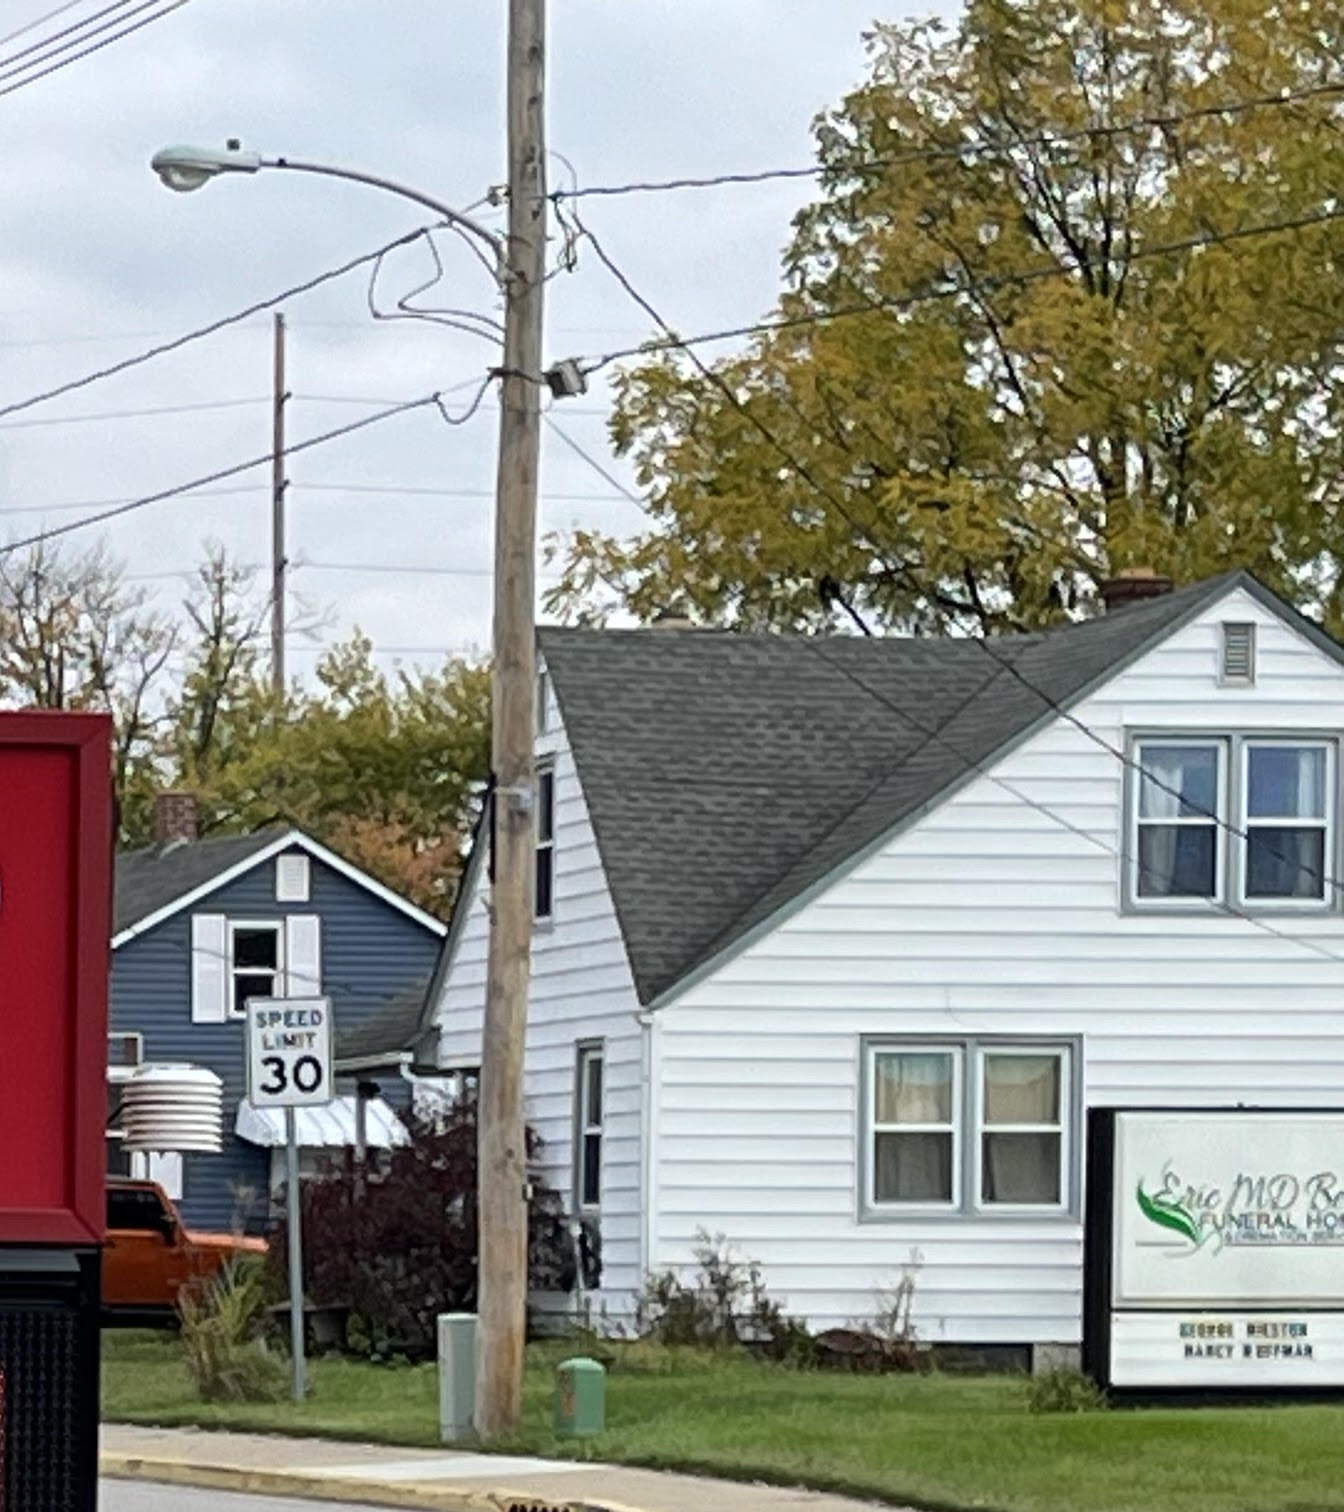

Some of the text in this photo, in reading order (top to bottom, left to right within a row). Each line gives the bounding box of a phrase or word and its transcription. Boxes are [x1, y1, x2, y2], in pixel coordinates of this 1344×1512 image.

[256, 1009, 322, 1028] SPEED
[261, 1032, 316, 1050] LIMIT
[260, 1055, 322, 1094] 30
[1199, 1212, 1297, 1230] FUNERAL
